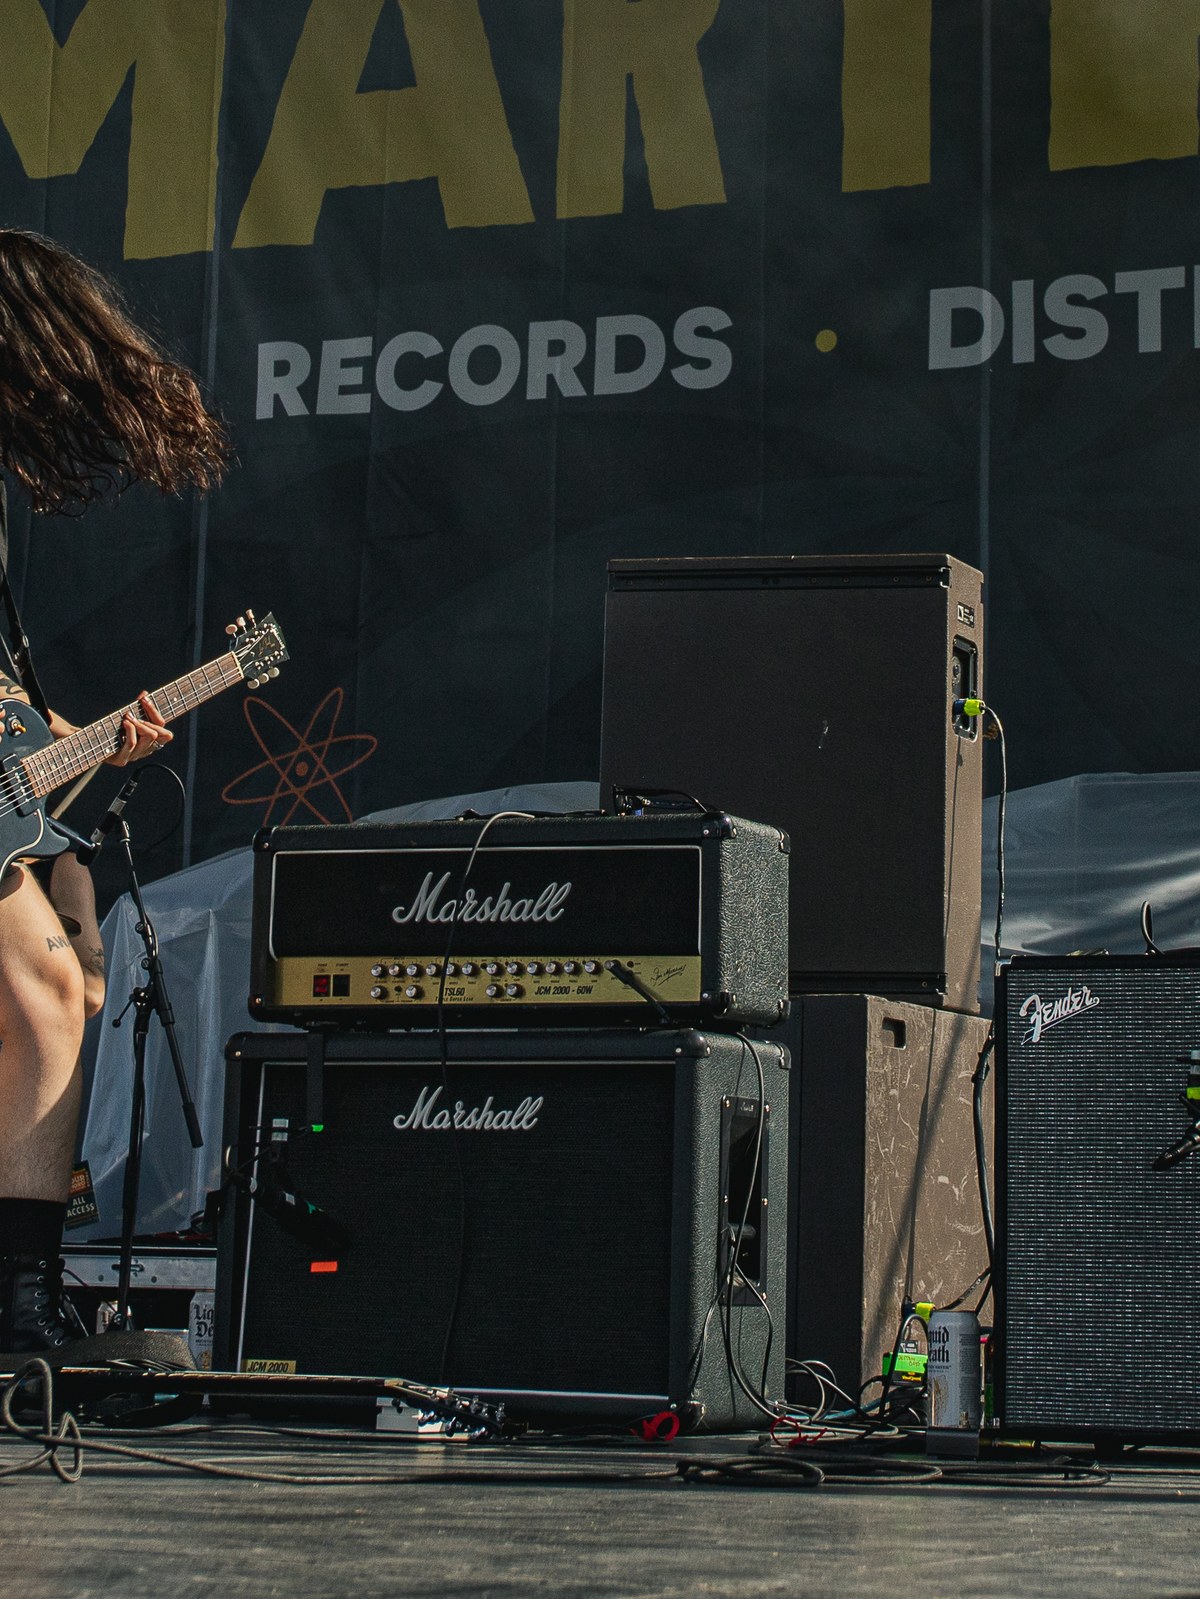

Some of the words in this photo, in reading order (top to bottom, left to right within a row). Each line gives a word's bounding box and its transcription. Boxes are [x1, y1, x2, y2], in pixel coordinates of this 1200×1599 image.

[255, 306, 734, 420] RECORDS
[928, 264, 1200, 370] DIST
[392, 871, 572, 923] Marshall
[535, 985, 551, 995] JCM
[552, 985, 571, 995] 2000
[1019, 986, 1100, 1045] Fender
[393, 1085, 544, 1130] Marshall
[66, 1203, 95, 1217] ACCESS
[72, 1196, 86, 1206] ALL
[248, 1361, 267, 1372] JCM
[268, 1362, 288, 1372] 2000
